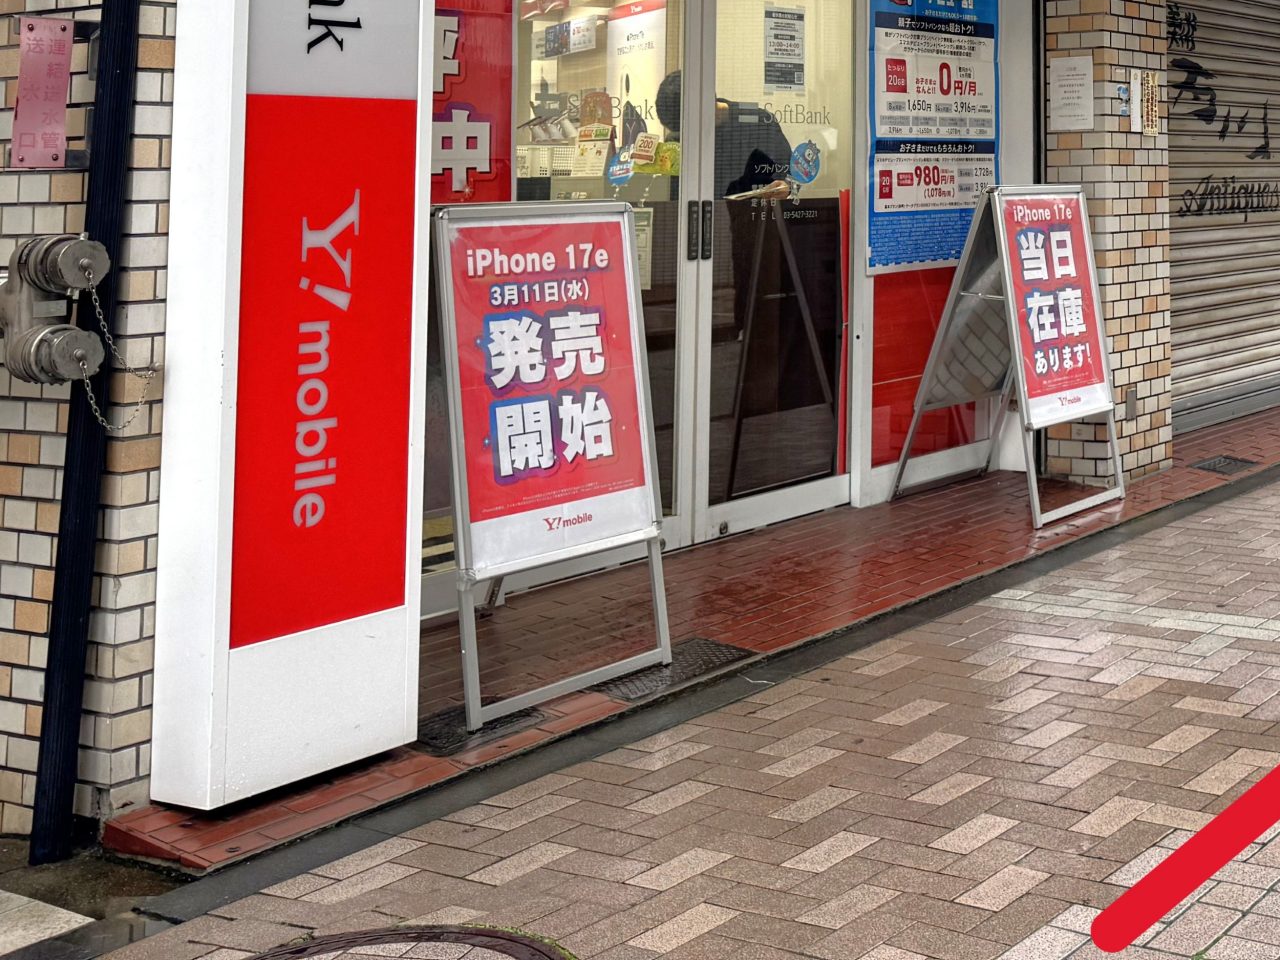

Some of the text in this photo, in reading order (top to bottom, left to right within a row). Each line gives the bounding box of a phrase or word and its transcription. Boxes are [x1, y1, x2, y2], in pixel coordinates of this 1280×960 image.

[763, 102, 831, 125] SoftBank
[907, 100, 932, 112] 1,650円
[953, 101, 976, 113] 3,916円
[638, 139, 654, 149] 200
[914, 165, 941, 187] 980
[1012, 203, 1073, 223] iPhone 17e
[466, 242, 610, 278] iPhone 17e
[1019, 229, 1078, 282] 当日
[490, 276, 590, 307] 3月11日(水)
[1026, 287, 1087, 344] 在庫
[293, 188, 362, 529] Y!mobile
[487, 310, 606, 390] 発売
[1033, 342, 1093, 376] あります!
[494, 390, 615, 478] 開始
[542, 511, 593, 532] Y!mobile
